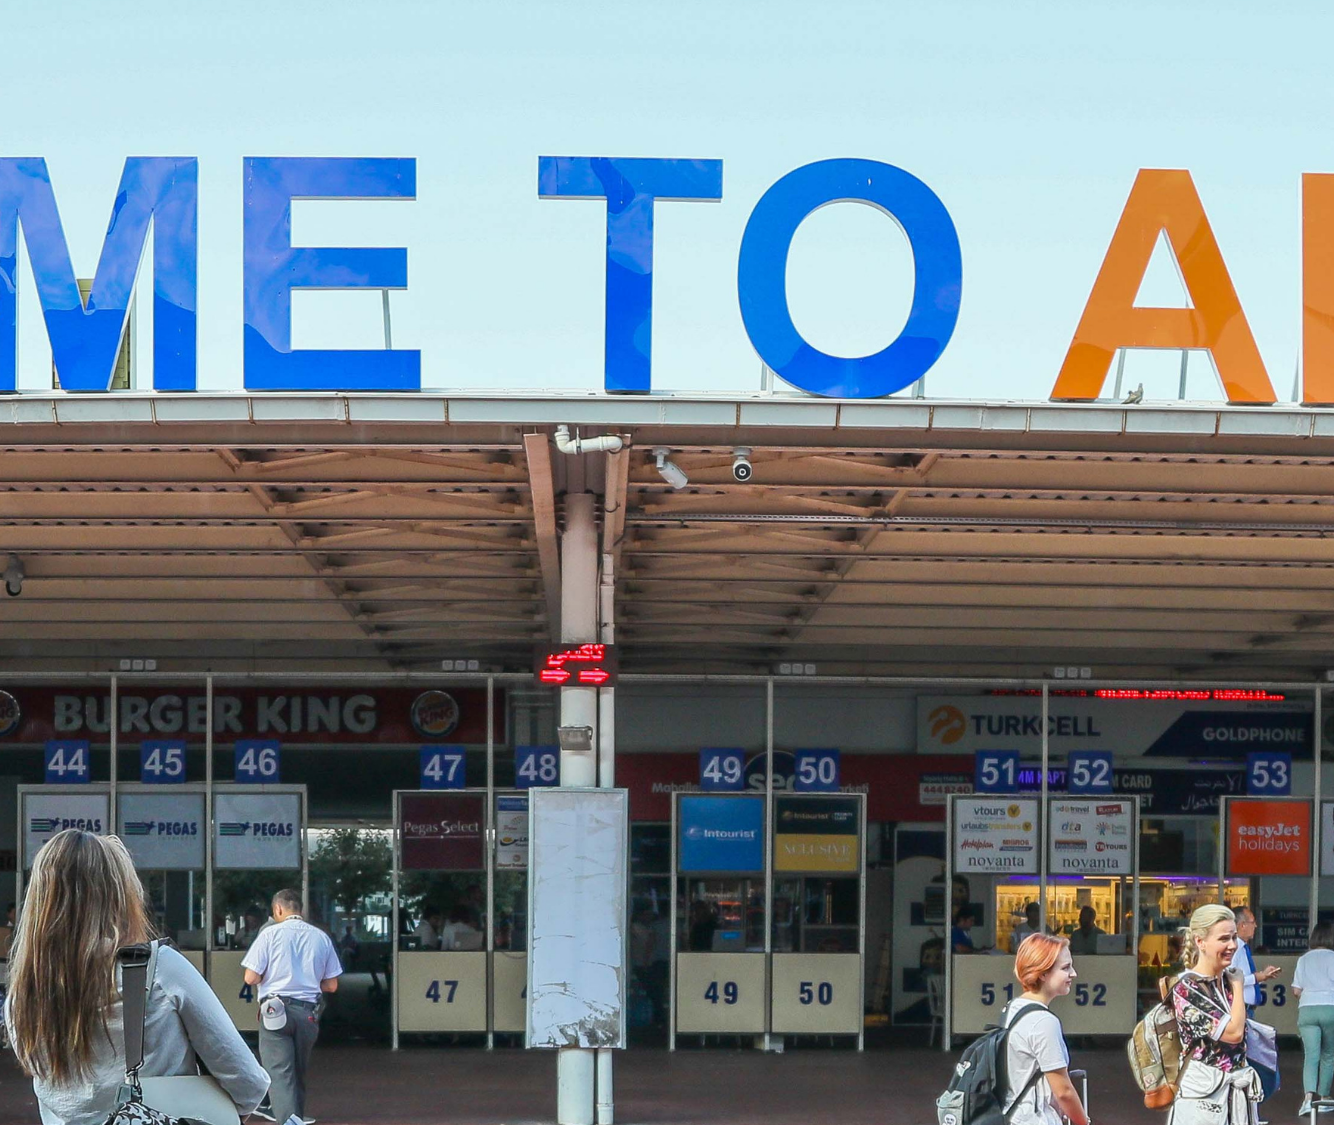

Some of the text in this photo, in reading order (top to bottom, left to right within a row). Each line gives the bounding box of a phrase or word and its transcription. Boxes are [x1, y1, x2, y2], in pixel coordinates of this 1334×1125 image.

[538, 156, 963, 398] TO
[54, 695, 376, 733] BURGER KING
[971, 715, 1101, 737] TURKCELL
[1202, 727, 1305, 742] GOLDPHONE
[48, 749, 86, 775] 44
[144, 749, 183, 775] 45
[238, 748, 276, 775] 46
[424, 754, 462, 781] 47
[519, 754, 557, 781] 48
[703, 756, 741, 783] 49
[799, 757, 836, 784] 50
[981, 758, 1015, 785] 51
[1073, 759, 1109, 786] 52
[1122, 775, 1152, 788] CARD
[1252, 761, 1288, 787] 53
[839, 783, 869, 793] arketi
[974, 806, 1005, 815] vtours
[62, 818, 101, 832] PEGAS
[158, 822, 197, 836] PEGAS
[253, 822, 293, 836] PEGAS
[404, 820, 479, 835] Pegas Select
[704, 829, 756, 838] Intourist
[1238, 823, 1300, 838] easyJet
[1239, 837, 1300, 853] holidays
[968, 856, 1024, 867] novanta
[1062, 857, 1119, 868] novanta
[1277, 927, 1296, 936] SIM
[1277, 938, 1308, 947] INTER
[239, 982, 254, 1003] 4
[425, 980, 459, 1003] 47
[704, 981, 738, 1004] 49
[799, 982, 833, 1005] 50
[981, 983, 1014, 1005] 51
[1075, 983, 1107, 1006] 52
[1259, 984, 1286, 1007] 53
